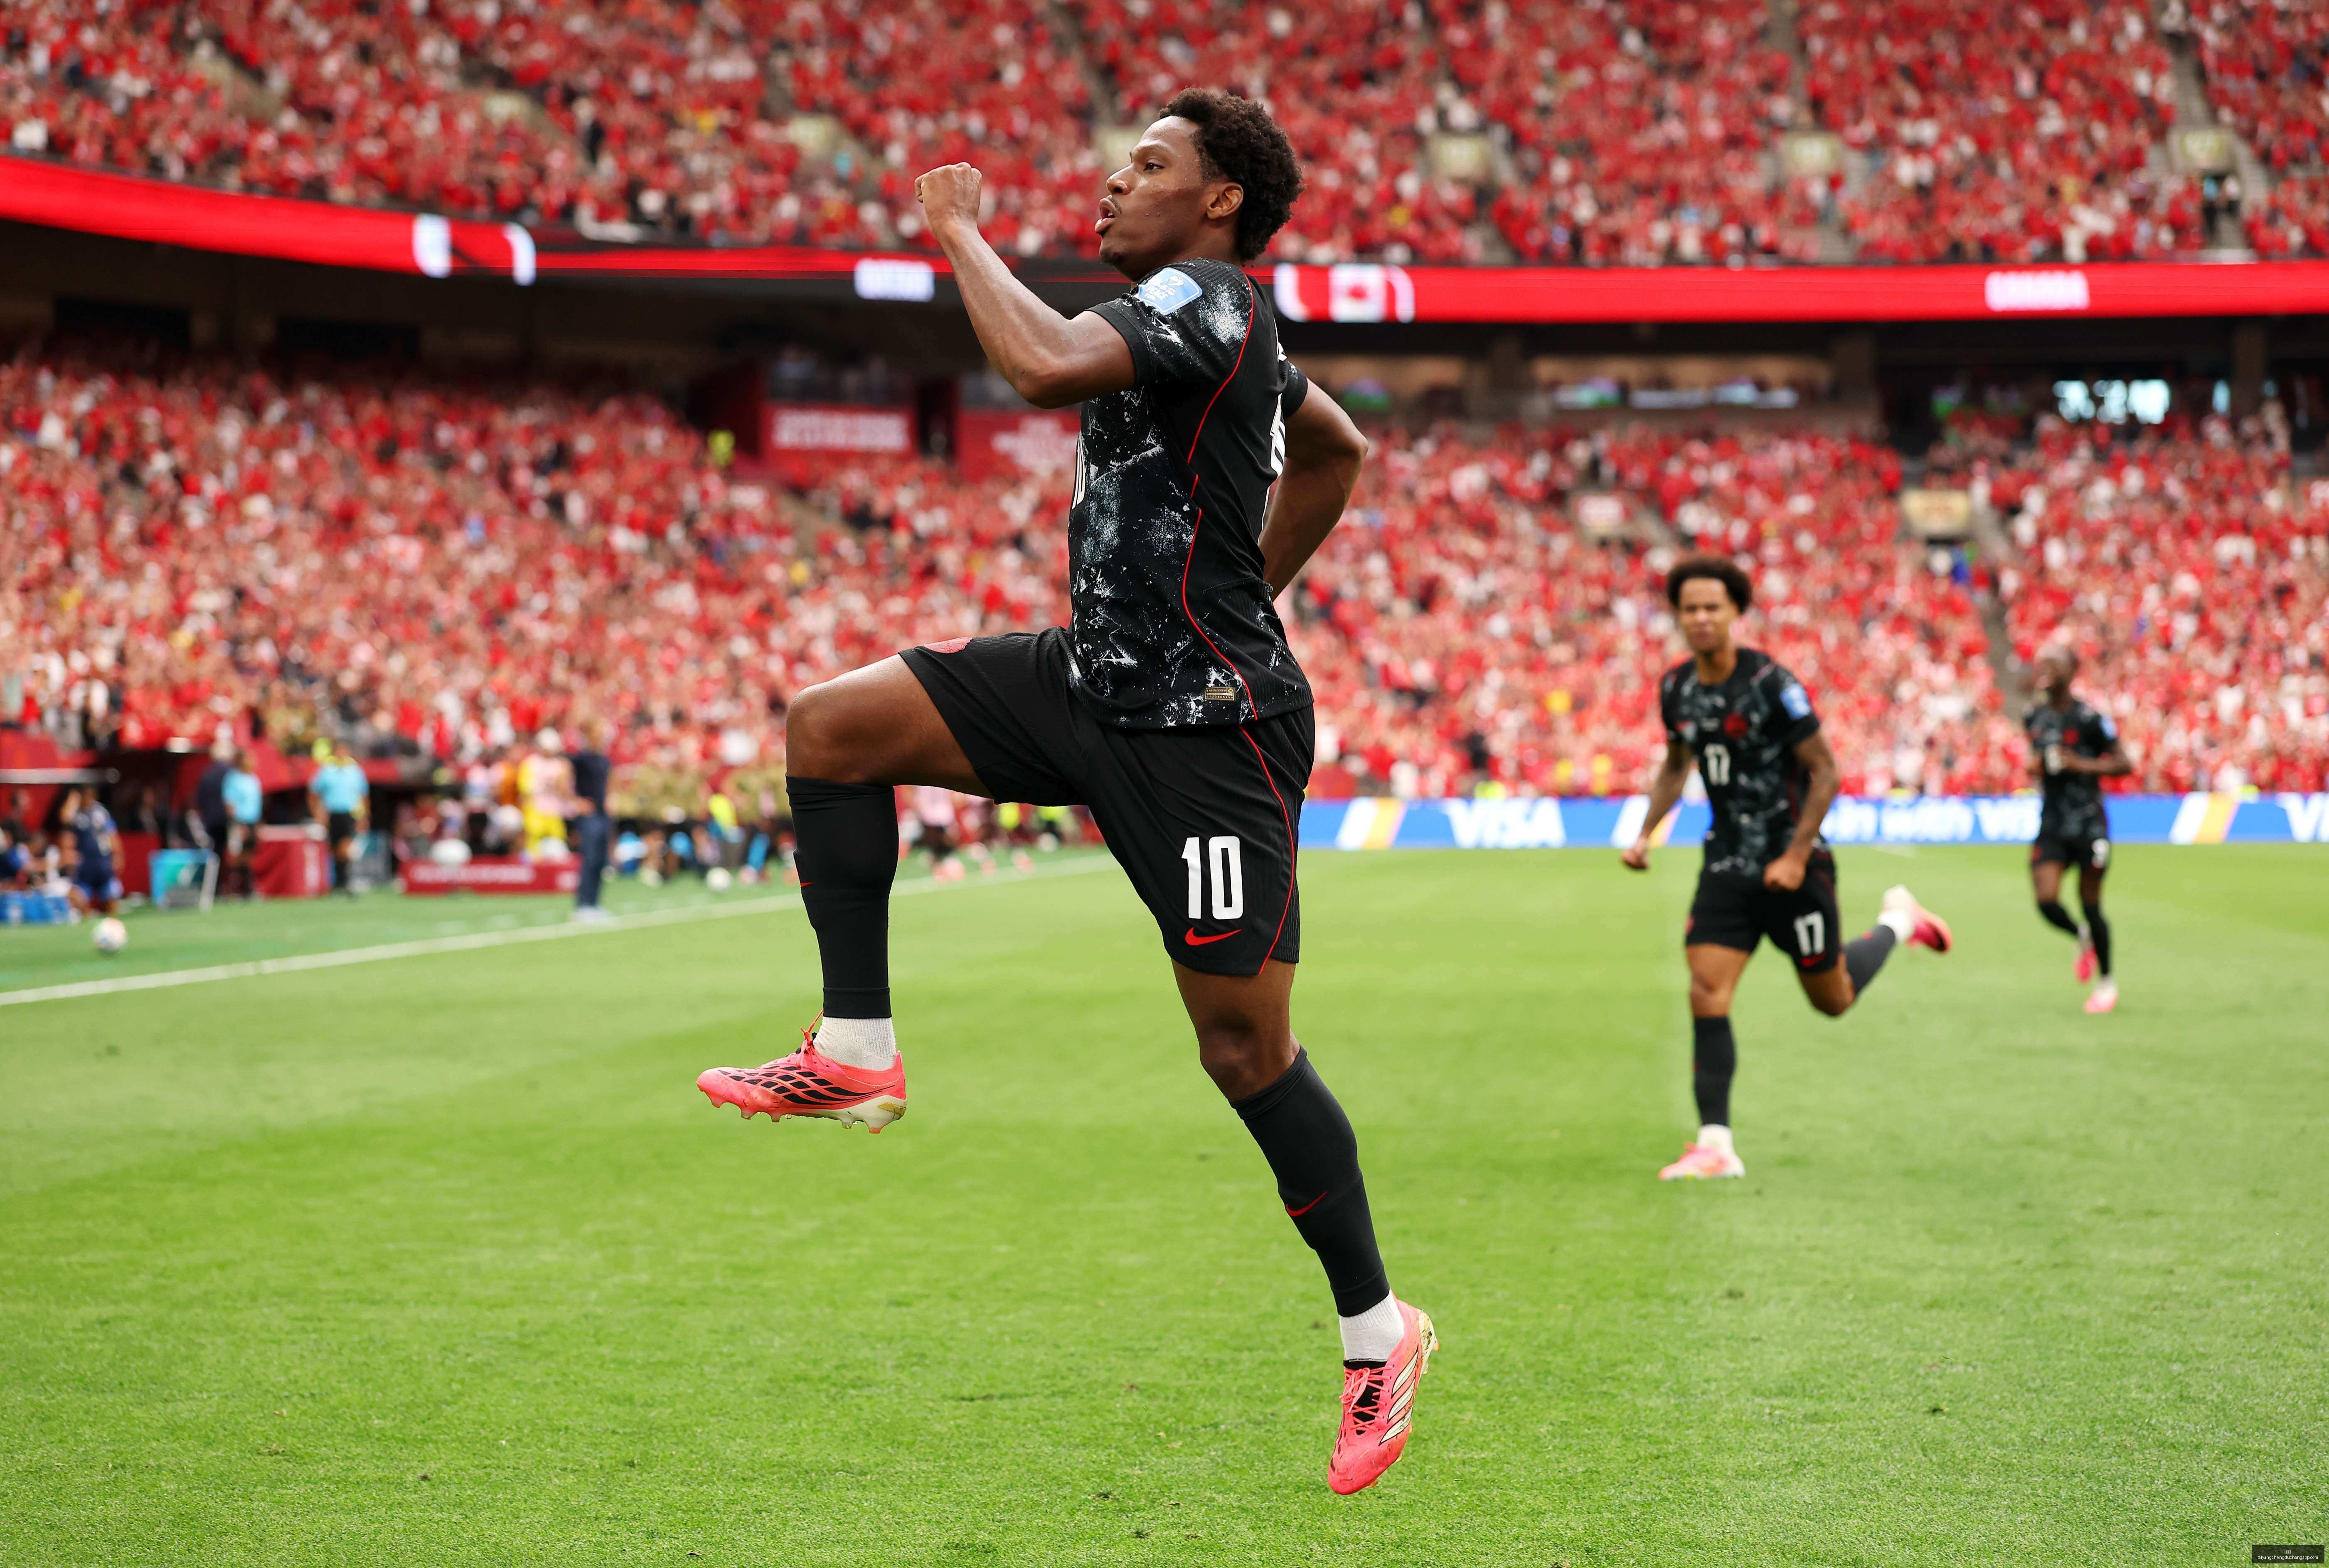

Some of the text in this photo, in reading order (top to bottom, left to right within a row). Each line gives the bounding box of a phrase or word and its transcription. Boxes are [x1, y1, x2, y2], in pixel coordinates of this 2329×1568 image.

[1704, 743, 1731, 785] 17
[1441, 796, 1567, 849] VISA
[1975, 796, 2042, 842] VIS
[1181, 836, 1243, 920] 10
[1794, 911, 1825, 956] 17
